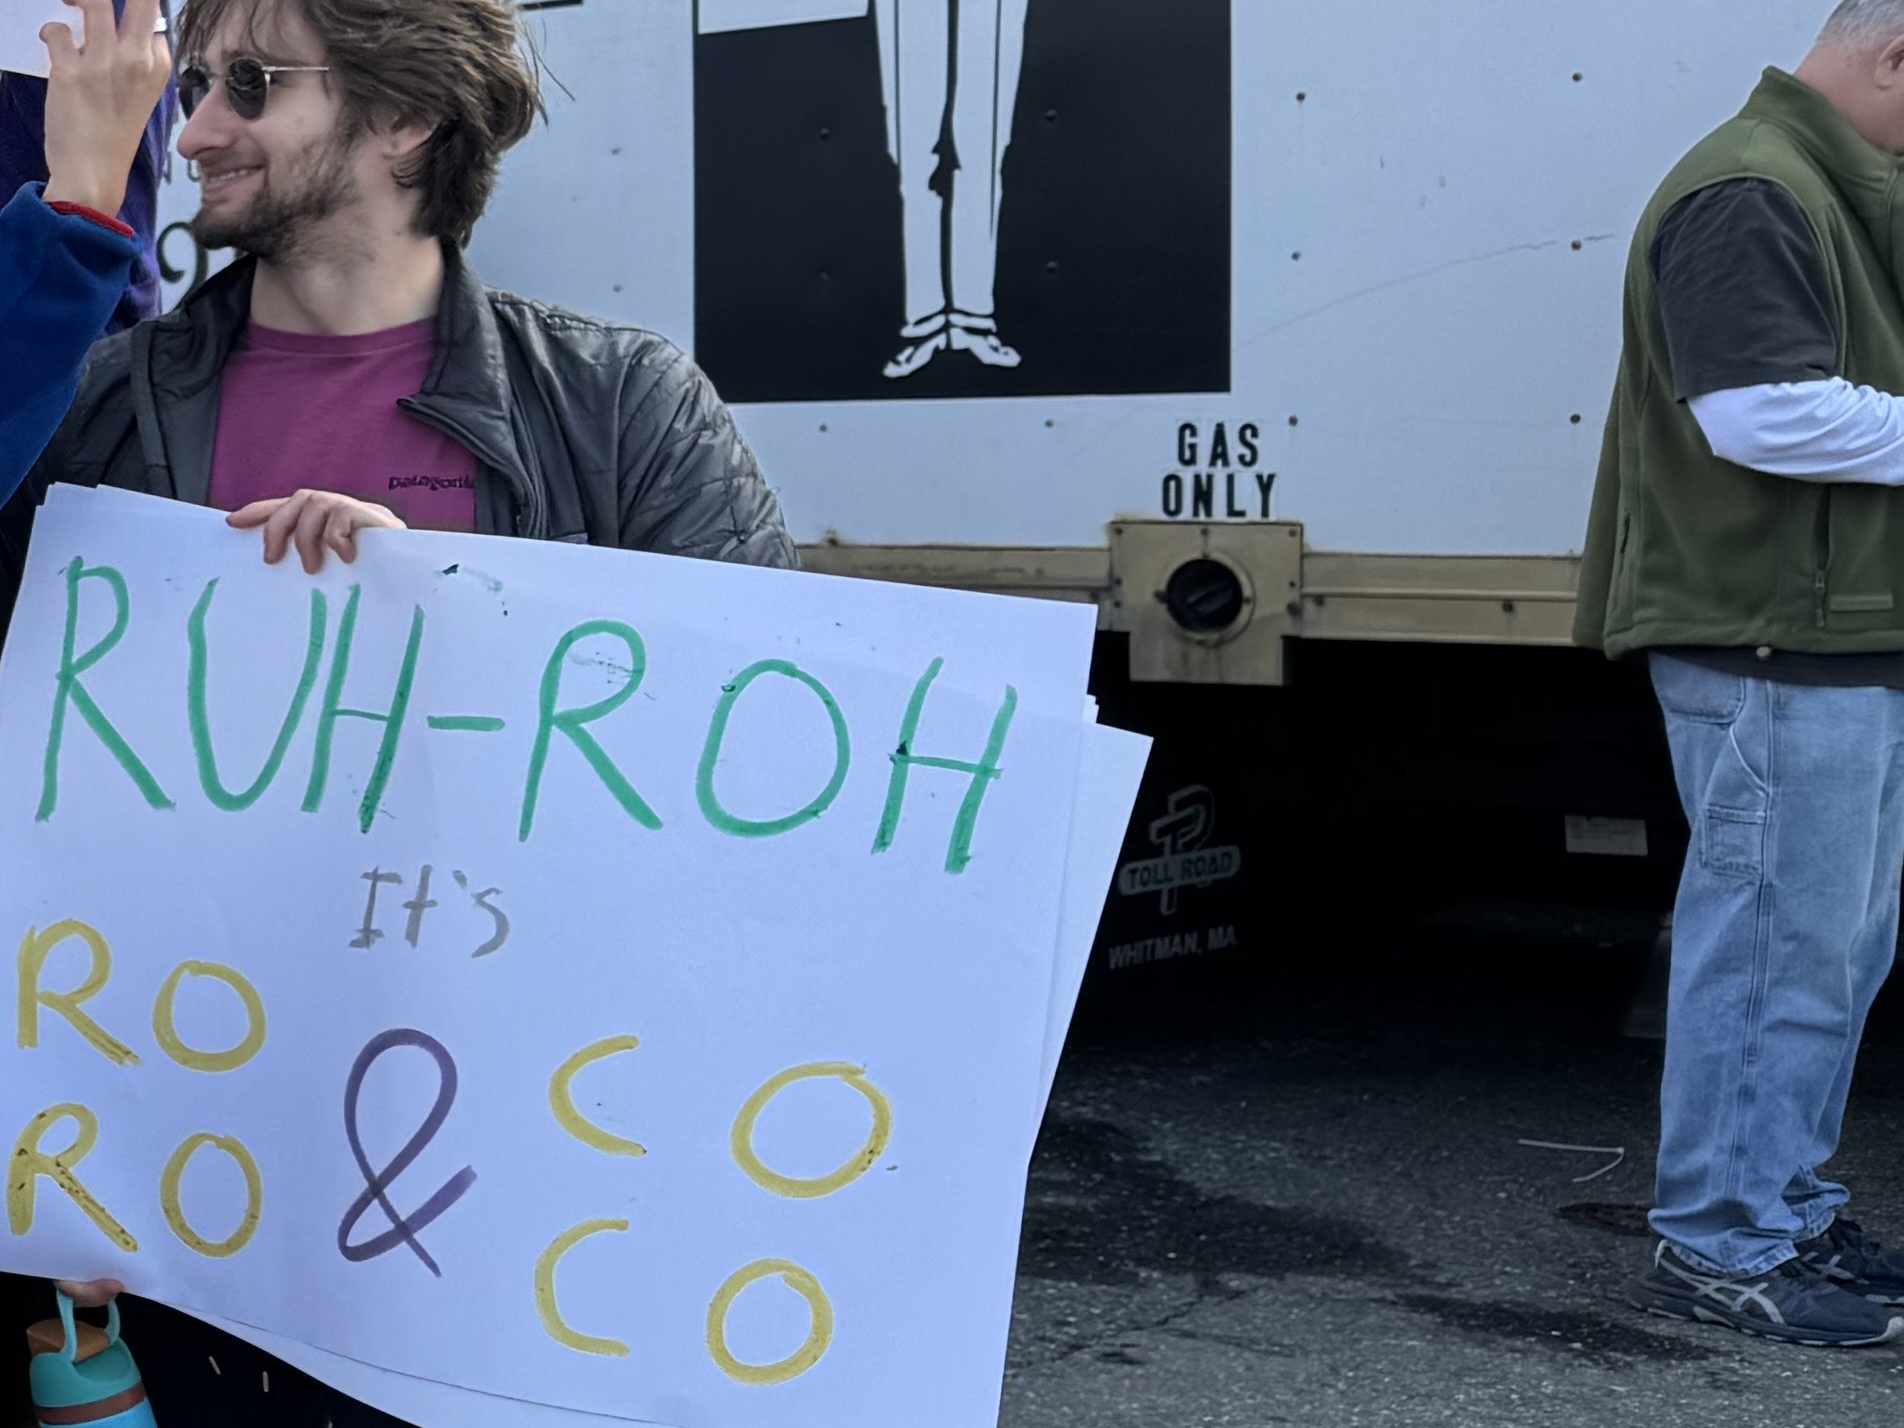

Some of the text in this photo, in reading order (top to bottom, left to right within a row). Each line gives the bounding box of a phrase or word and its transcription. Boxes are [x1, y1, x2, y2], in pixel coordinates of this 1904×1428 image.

[1161, 472, 1276, 519] ONLY
[1177, 421, 1260, 468] GAS
[35, 555, 1018, 876] RUH-ROH
[1128, 850, 1234, 890] TOLL ROAD
[17, 918, 268, 1074] RO
[7, 1102, 264, 1258] RO
[337, 1028, 478, 1278] &
